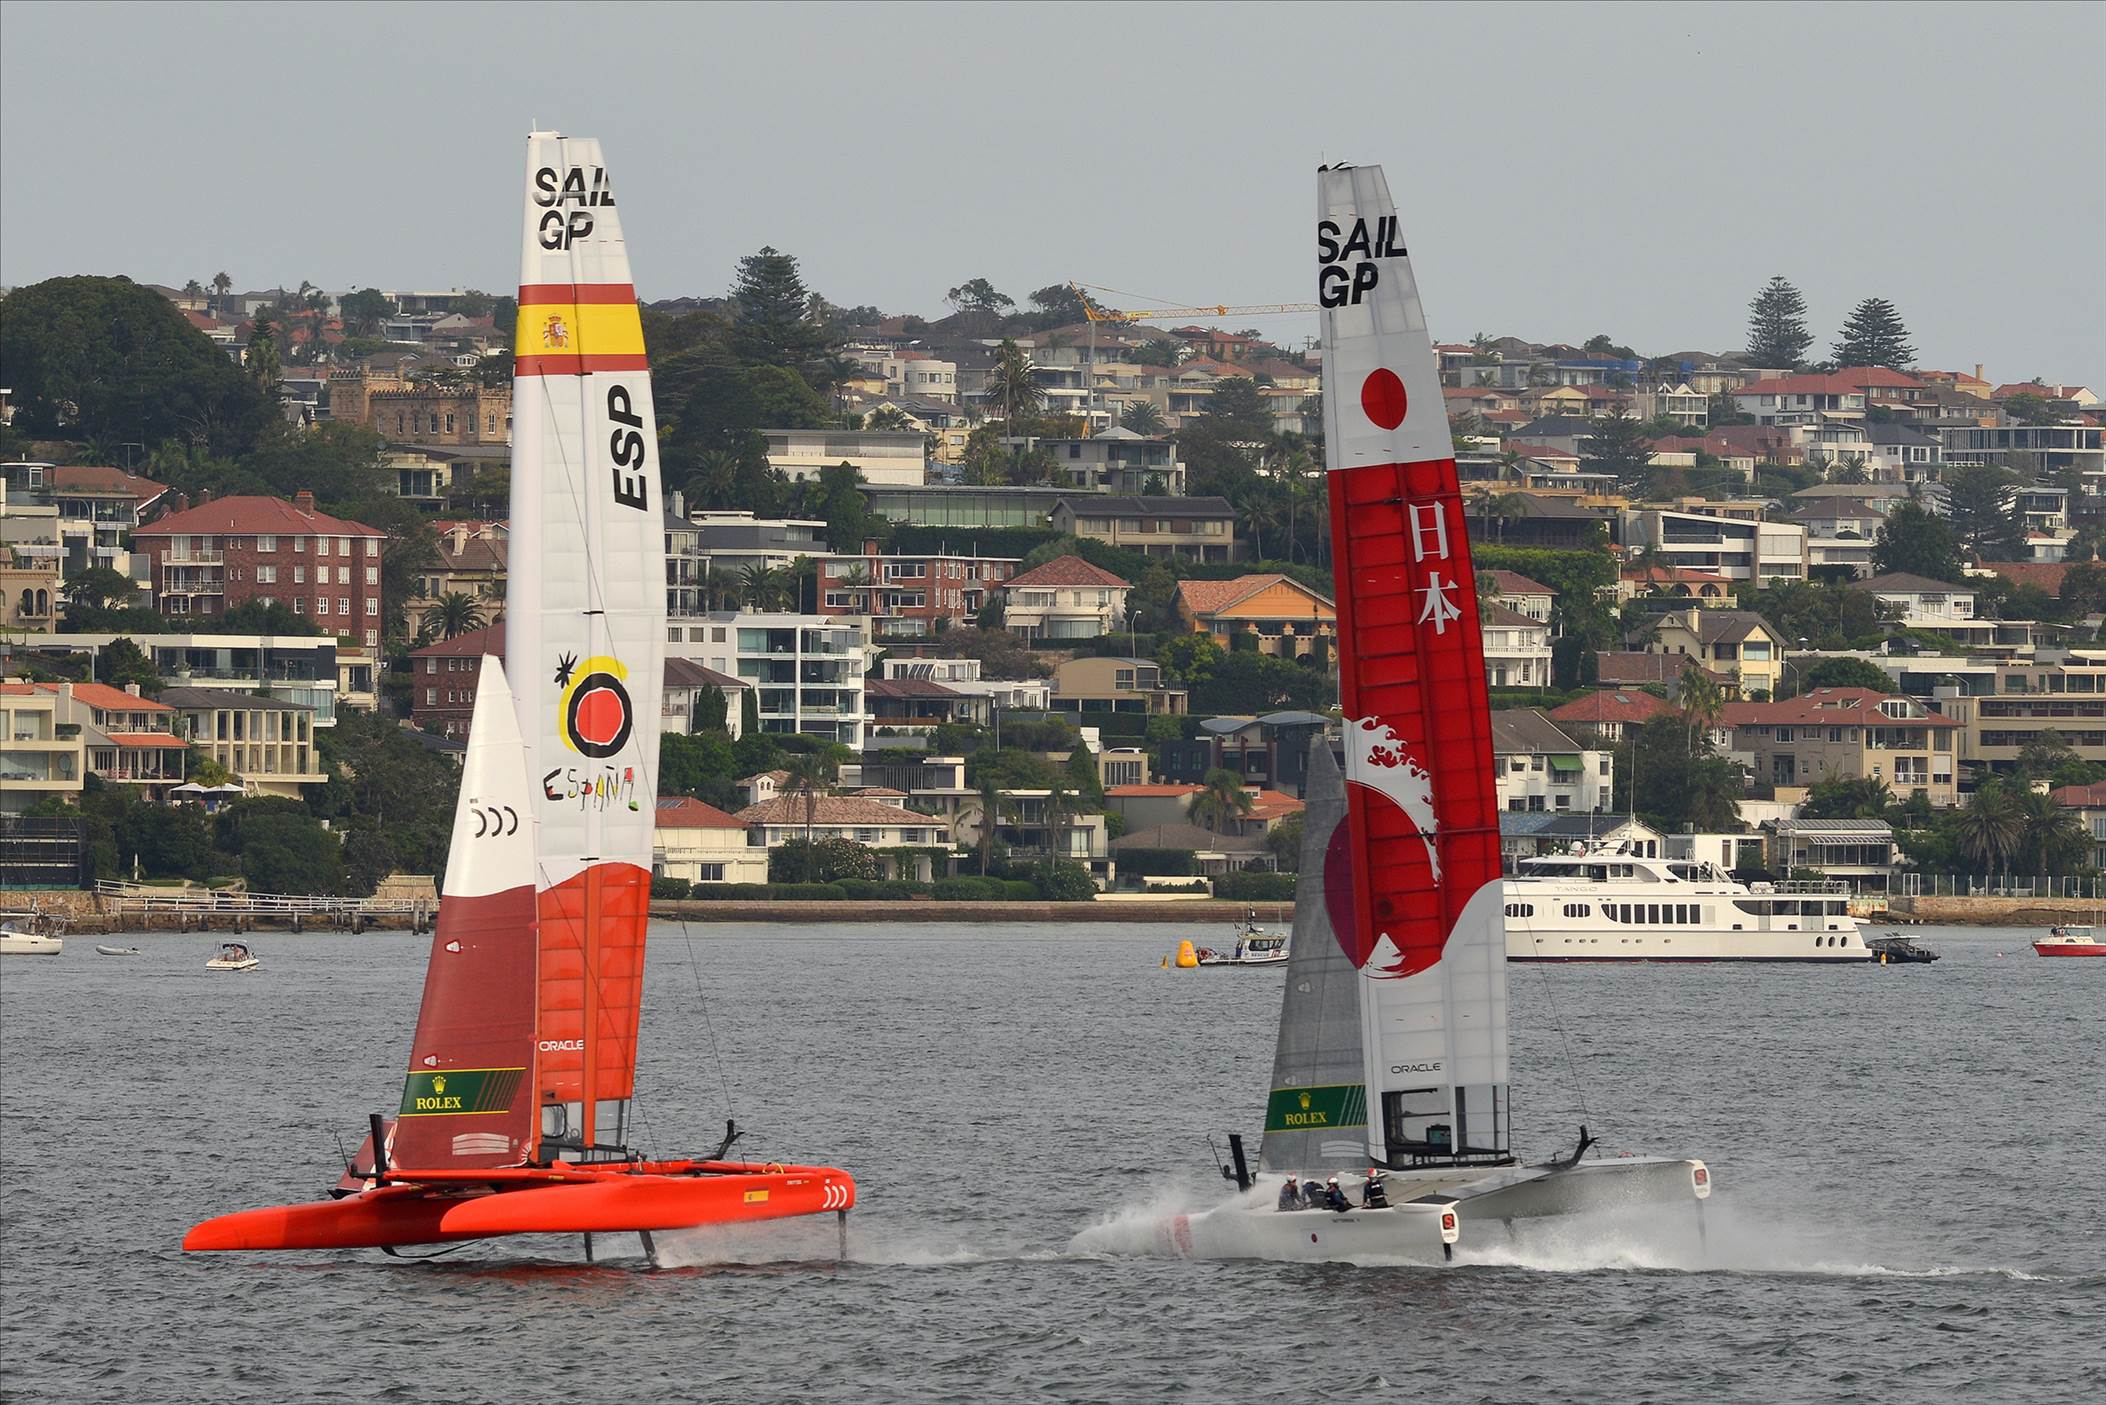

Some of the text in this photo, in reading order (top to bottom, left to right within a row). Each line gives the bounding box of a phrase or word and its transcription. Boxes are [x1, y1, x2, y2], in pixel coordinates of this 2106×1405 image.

[532, 167, 616, 207] SAIL
[538, 210, 594, 250] GP
[1318, 215, 1408, 264] SAIL
[1319, 262, 1379, 309] GP
[607, 384, 648, 512] ESP
[1408, 500, 1462, 635] 日本
[538, 1039, 584, 1052] ORACLE
[1390, 1062, 1441, 1074] ORACLE
[415, 1096, 462, 1110] ROLEX
[1284, 1111, 1328, 1126] ROLEX
